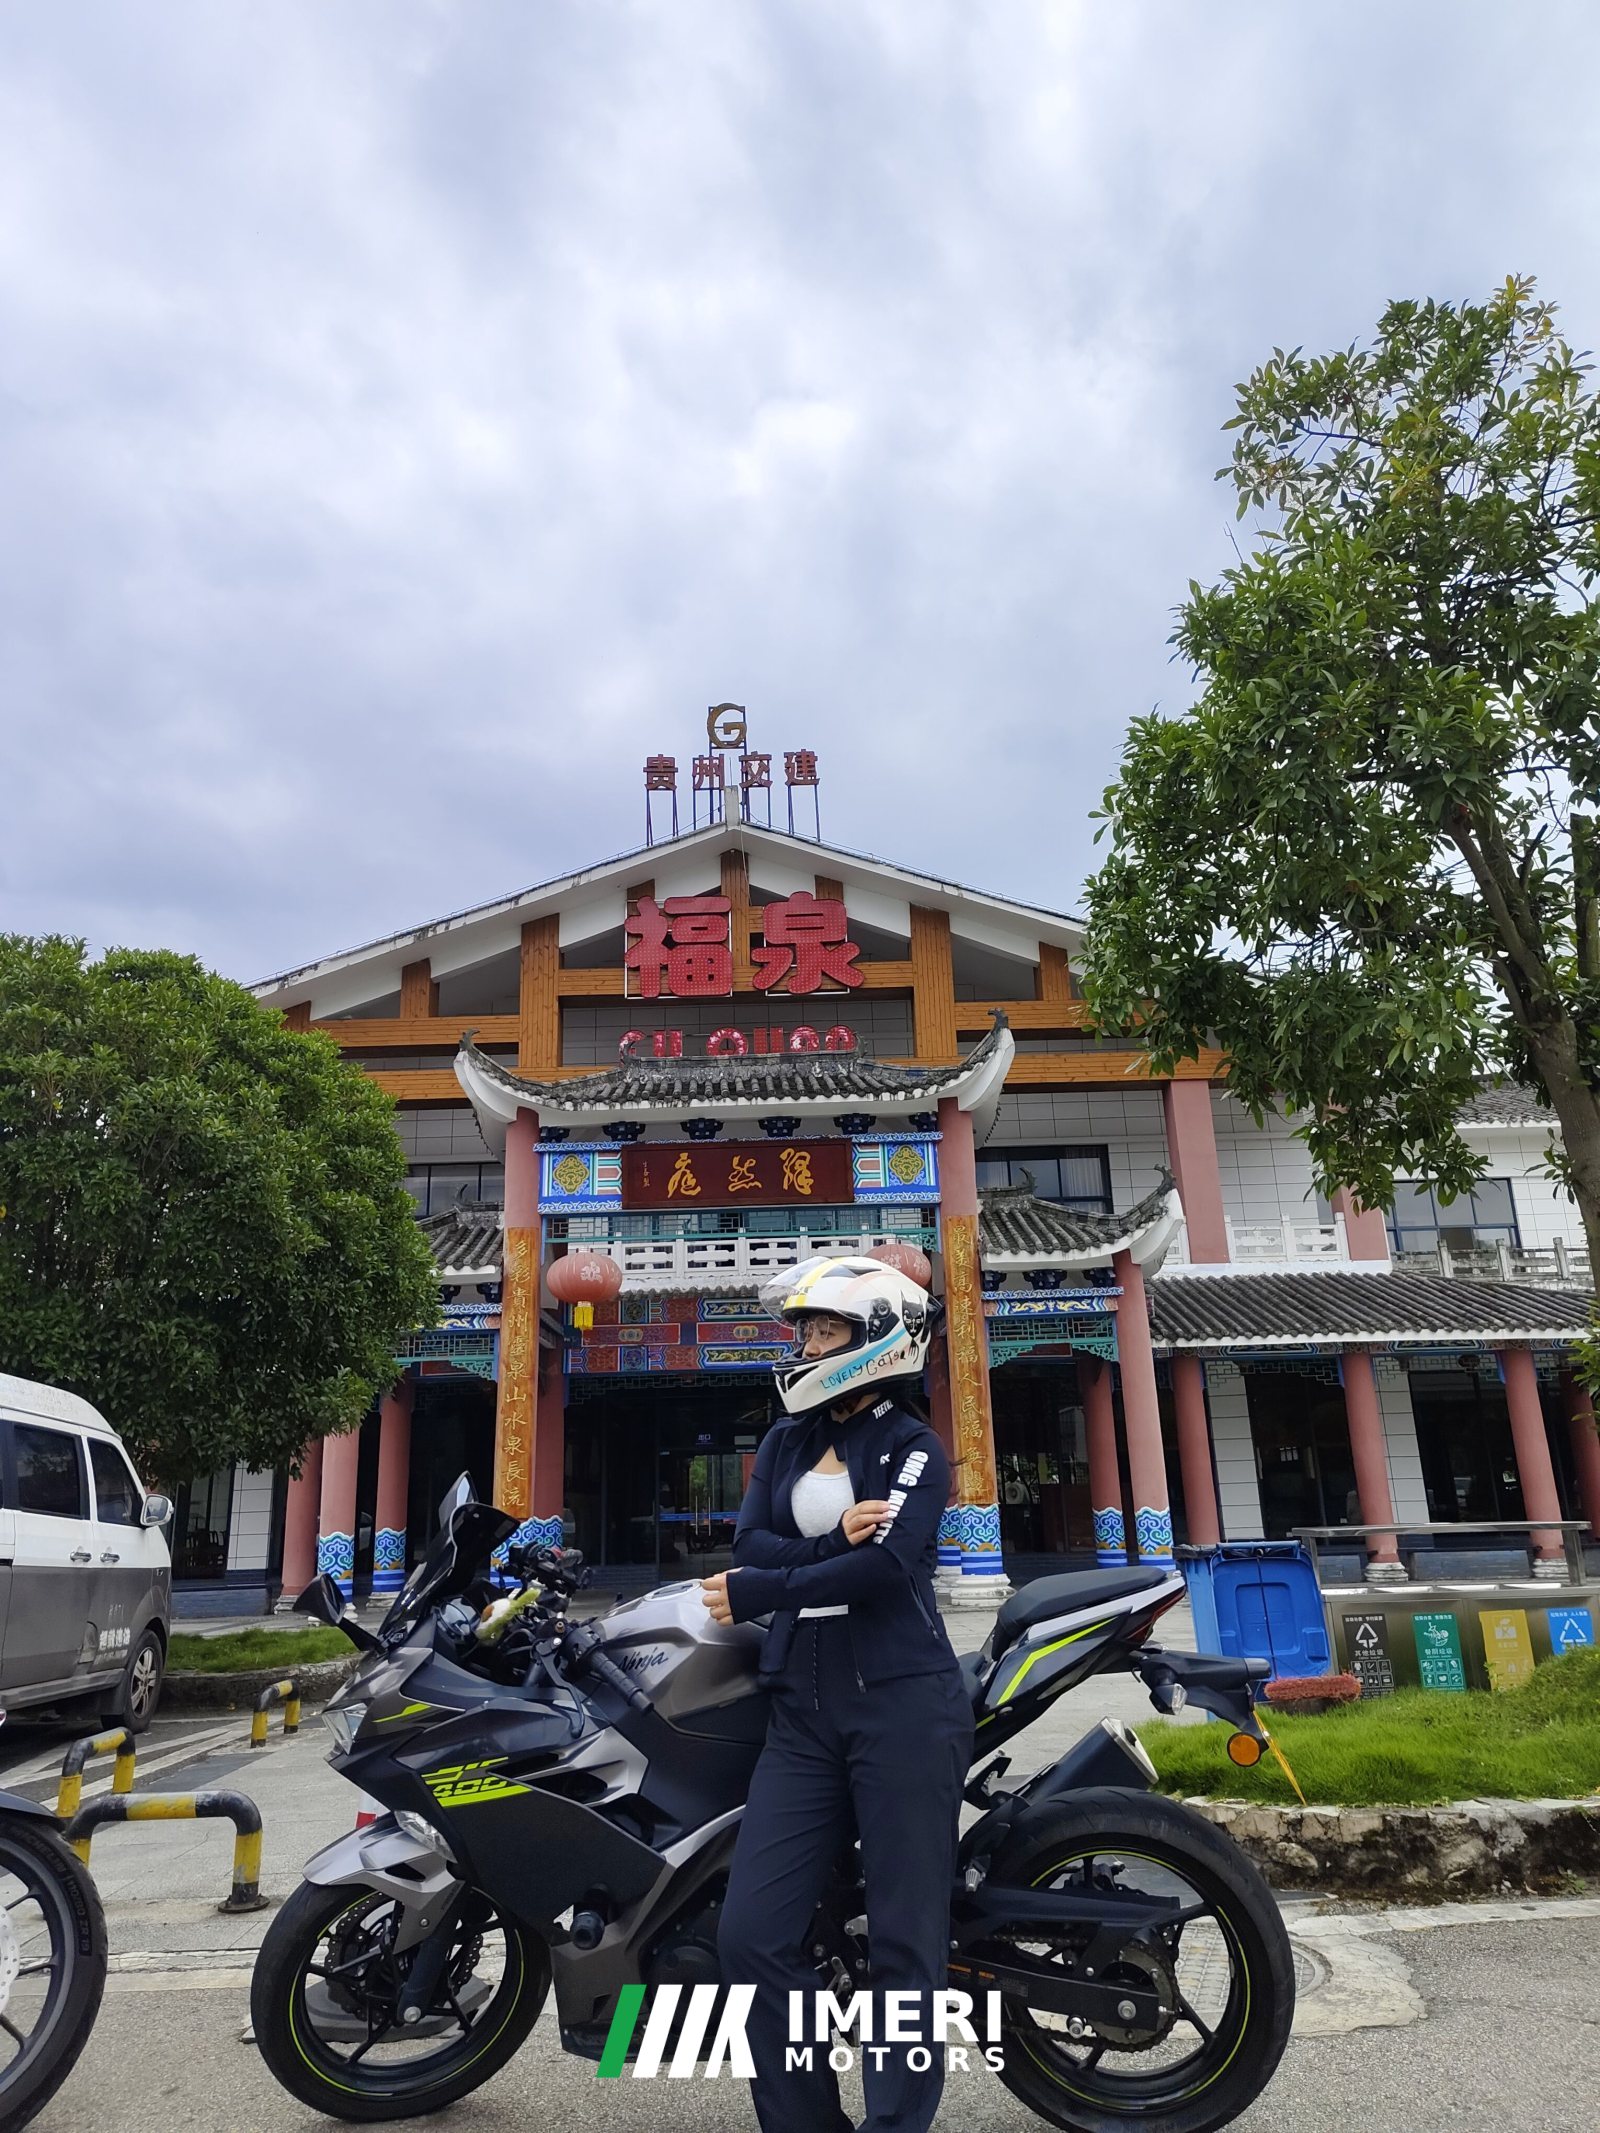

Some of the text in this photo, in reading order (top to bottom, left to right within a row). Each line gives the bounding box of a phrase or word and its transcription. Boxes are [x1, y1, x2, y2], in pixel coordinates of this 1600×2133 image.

[643, 749, 820, 791] 贵州交建
[624, 891, 865, 998] 福泉
[820, 1364, 863, 1389] LOVELY
[897, 1451, 929, 1487] OMG
[619, 1646, 669, 1676] Ninja
